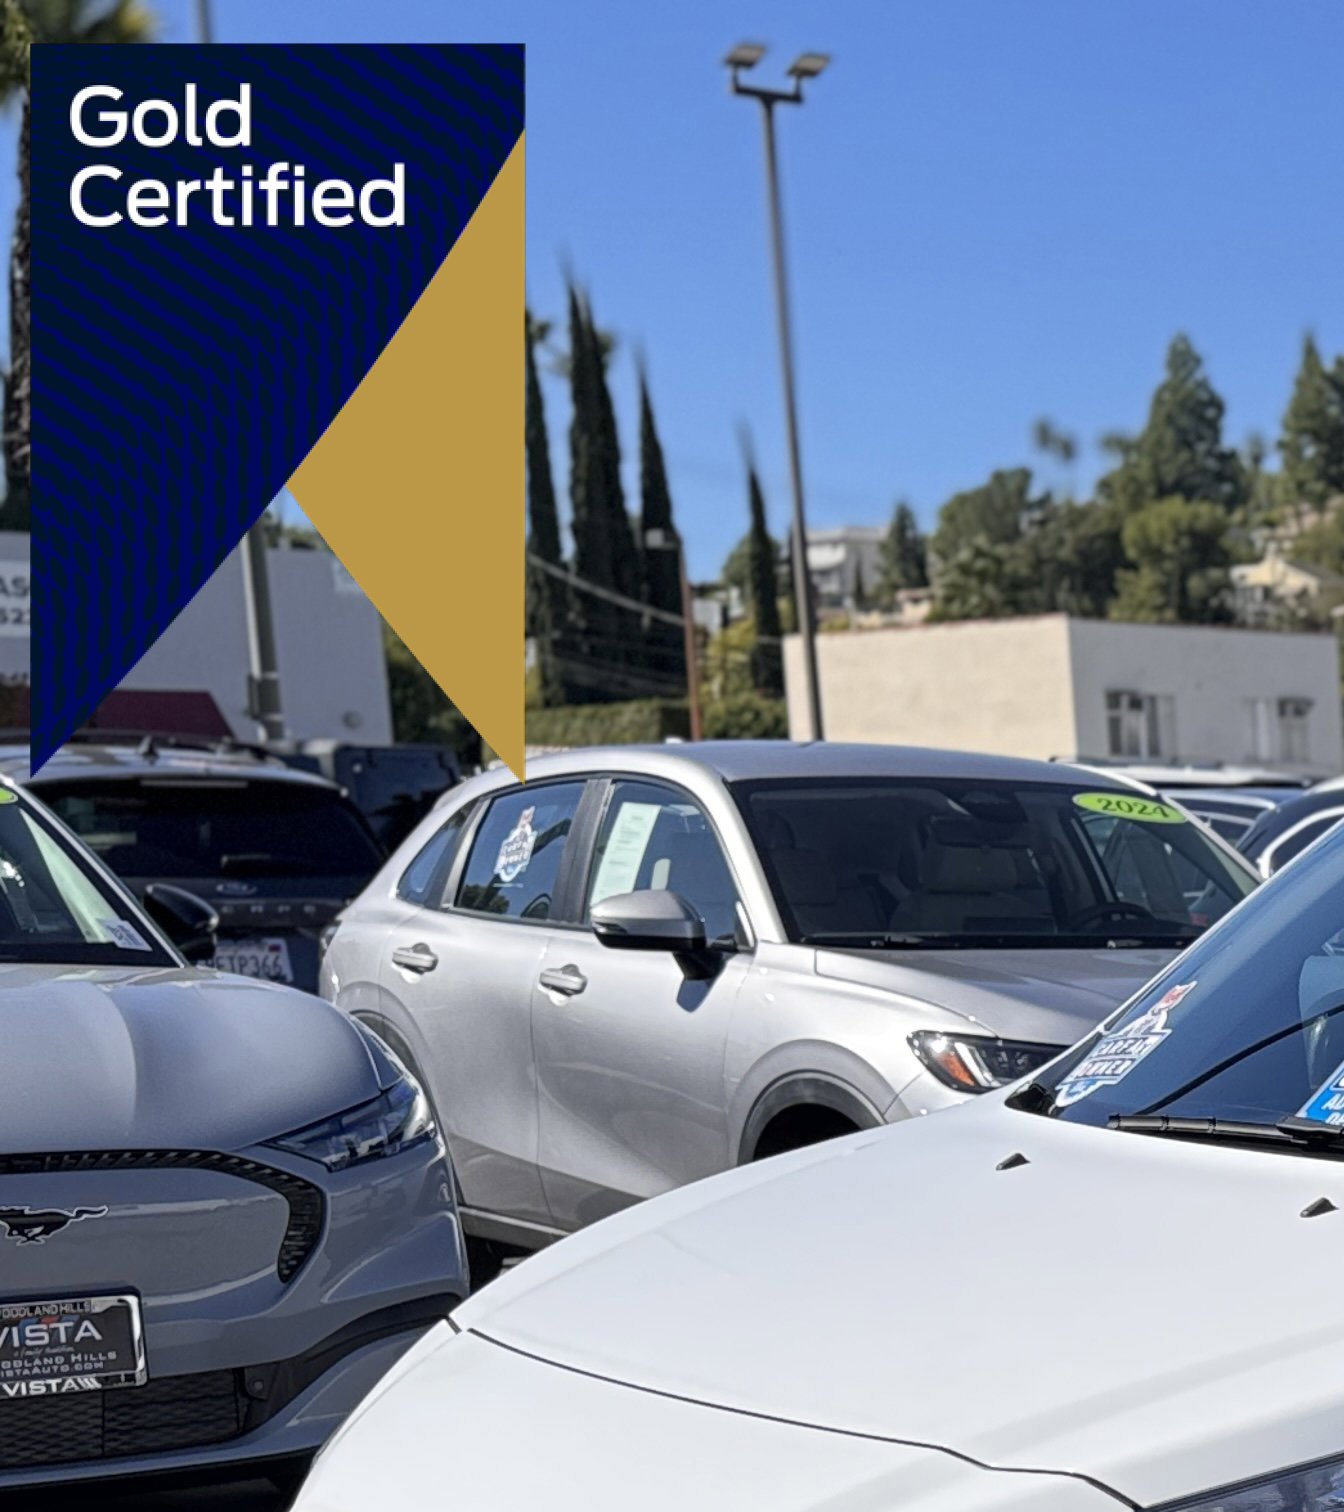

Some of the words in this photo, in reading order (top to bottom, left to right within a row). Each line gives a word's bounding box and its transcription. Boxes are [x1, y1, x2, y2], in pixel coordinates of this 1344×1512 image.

[1097, 798, 1170, 818] 2024
[71, 1350, 118, 1363] HILLS
[2, 1378, 81, 1398] VISTA
